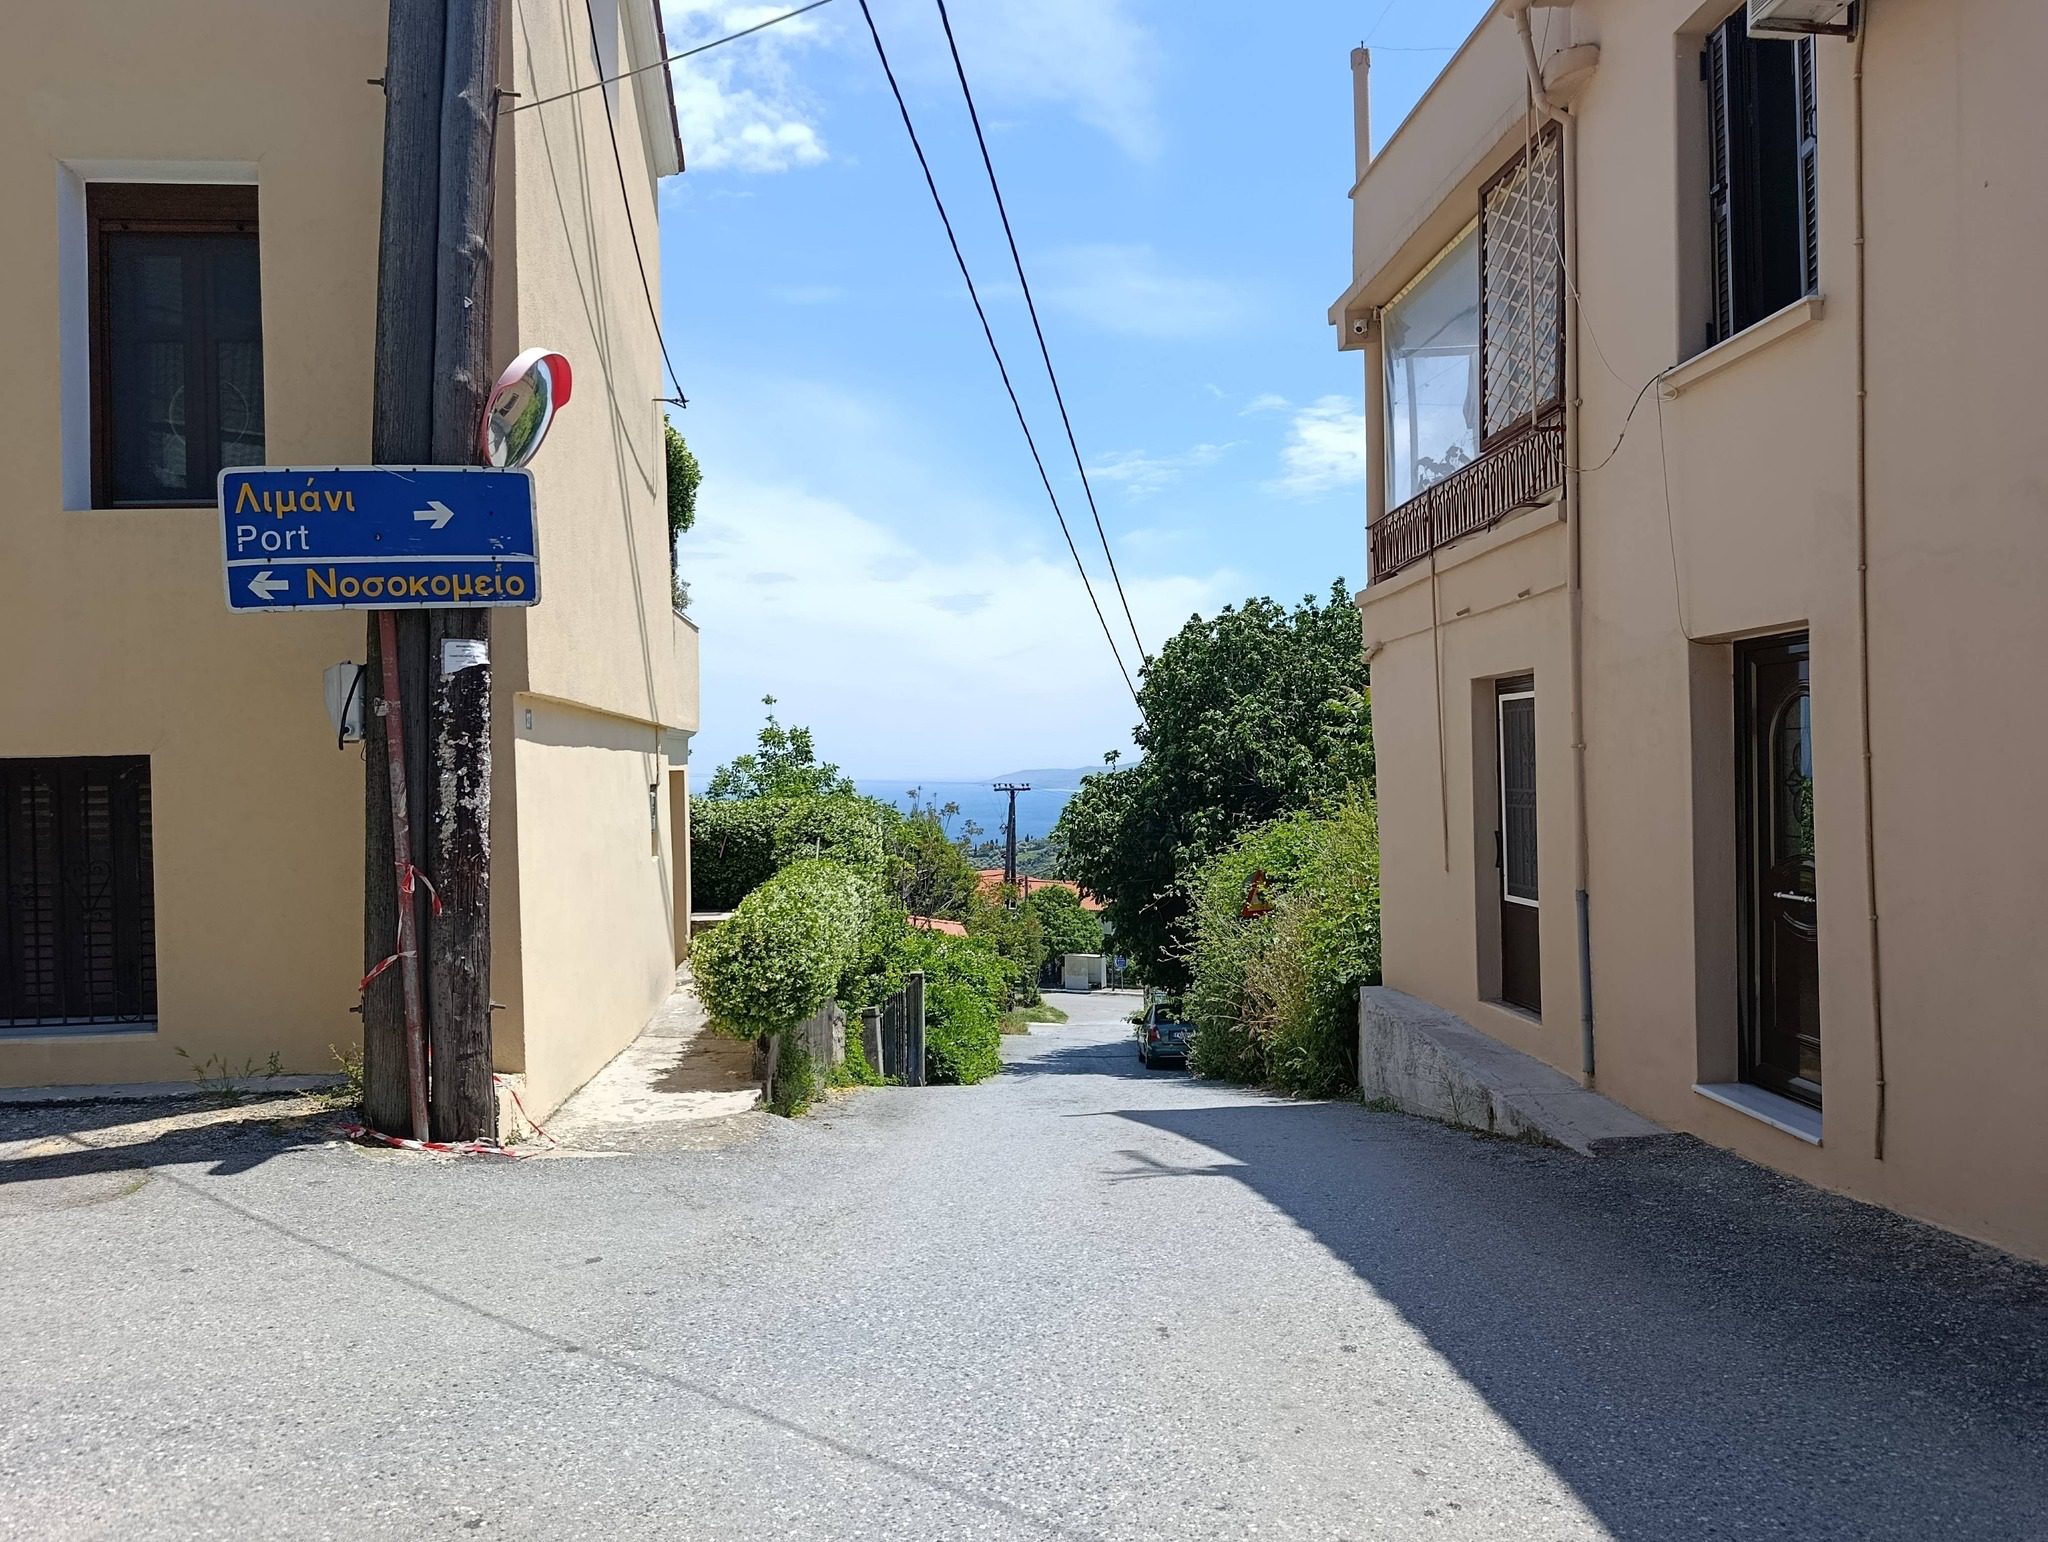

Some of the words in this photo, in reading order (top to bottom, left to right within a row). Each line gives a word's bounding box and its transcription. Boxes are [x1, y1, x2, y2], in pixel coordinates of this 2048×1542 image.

[235, 478, 355, 518] Λιμάνι
[237, 525, 309, 552] Port
[306, 564, 525, 601] Νοσοκομείο
